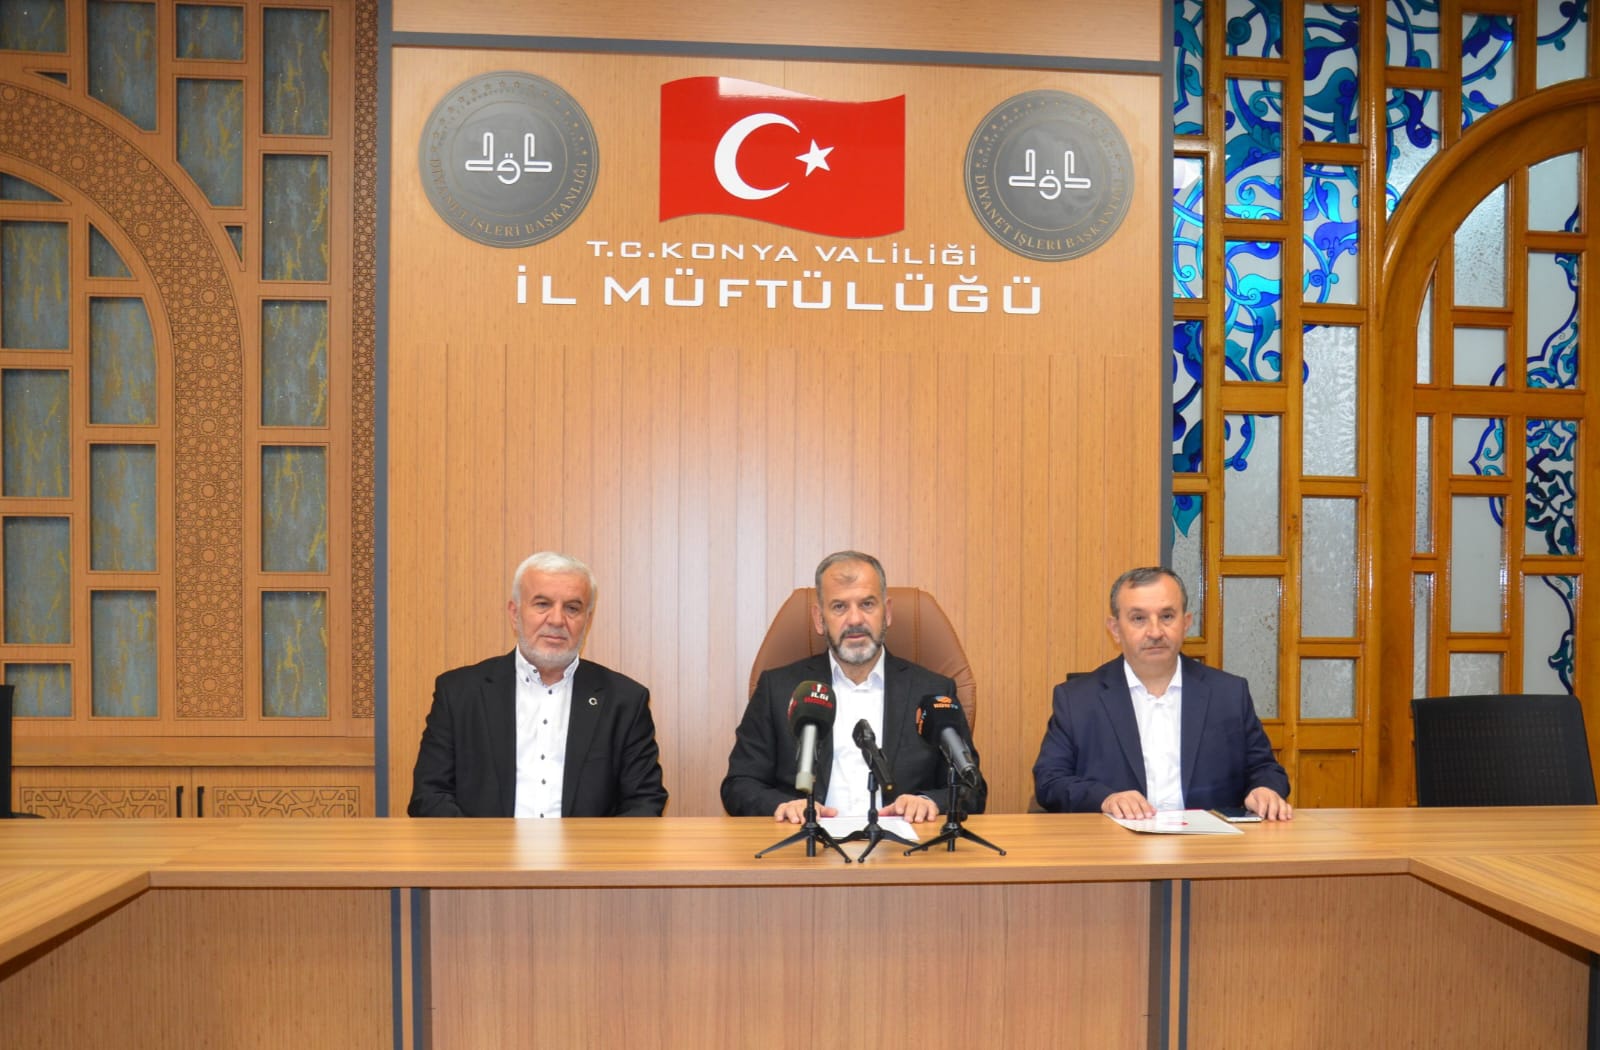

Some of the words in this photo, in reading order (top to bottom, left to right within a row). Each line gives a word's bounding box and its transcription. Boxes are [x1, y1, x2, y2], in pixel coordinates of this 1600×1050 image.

[975, 175, 1013, 234] DİYANET
[815, 243, 975, 265] VALİLİĞİ
[517, 265, 577, 305] İL
[604, 267, 1041, 314] MÜFTÜLÜĞÜ
